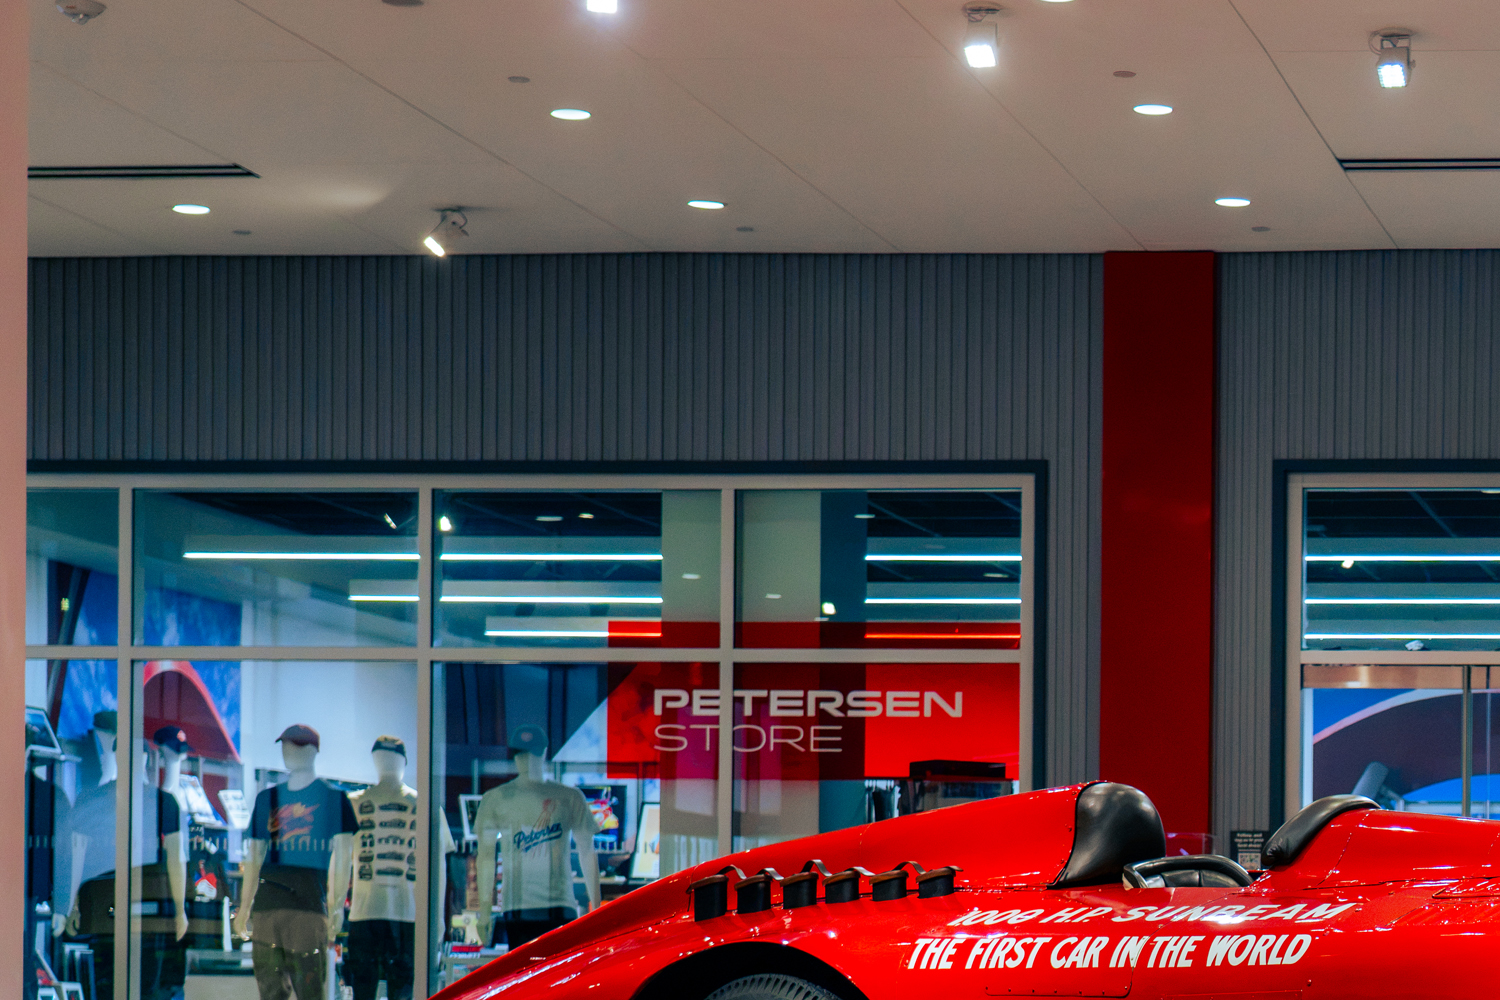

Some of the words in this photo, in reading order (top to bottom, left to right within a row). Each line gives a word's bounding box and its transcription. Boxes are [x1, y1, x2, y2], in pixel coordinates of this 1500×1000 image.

[653, 689, 963, 718] PETERSEN
[653, 724, 843, 752] STORE
[1039, 907, 1112, 923] H.P.
[1113, 901, 1357, 922] SUNBEAM
[907, 939, 965, 969] THE
[965, 937, 1052, 969] FIRST
[1050, 937, 1109, 968] CAR
[1109, 936, 1148, 968] IN
[1148, 936, 1198, 968] THE
[1207, 934, 1311, 966] WORLD
